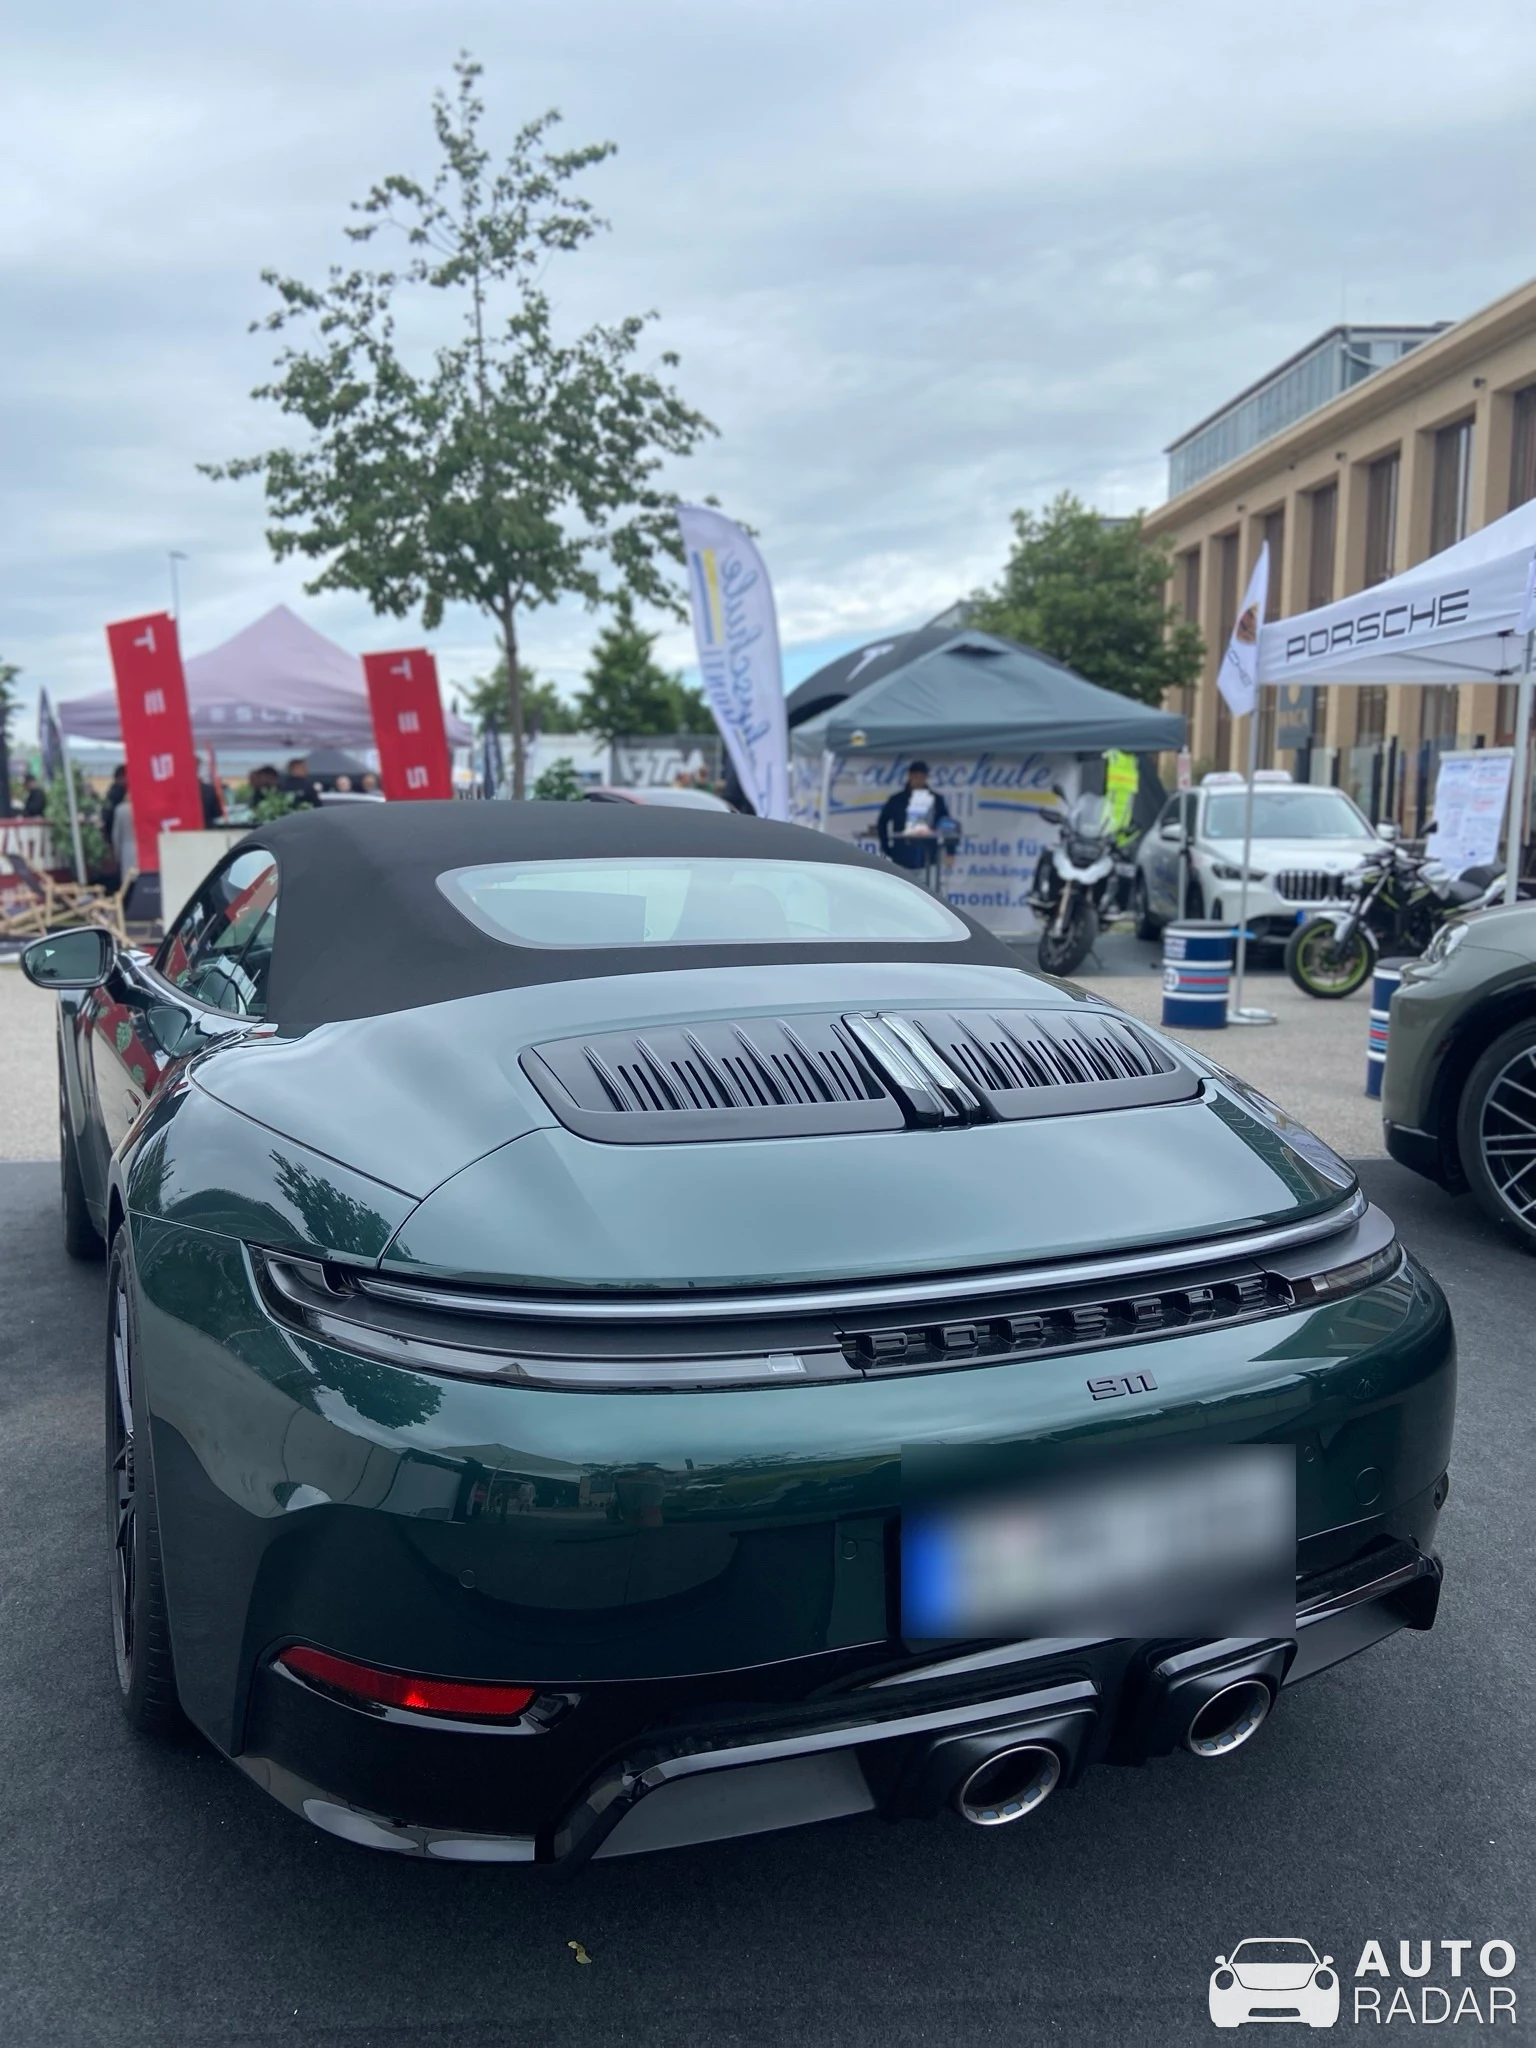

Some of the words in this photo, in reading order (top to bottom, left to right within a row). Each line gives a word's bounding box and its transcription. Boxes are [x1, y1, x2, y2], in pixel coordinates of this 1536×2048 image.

[1285, 588, 1470, 663] PORSCHE
[132, 625, 182, 831] TESL
[187, 705, 304, 724] ESLA
[389, 656, 429, 790] TES
[829, 752, 1052, 807] Fahschule
[865, 1278, 1269, 1359] PORSCHE
[1086, 1368, 1159, 1401] 911
